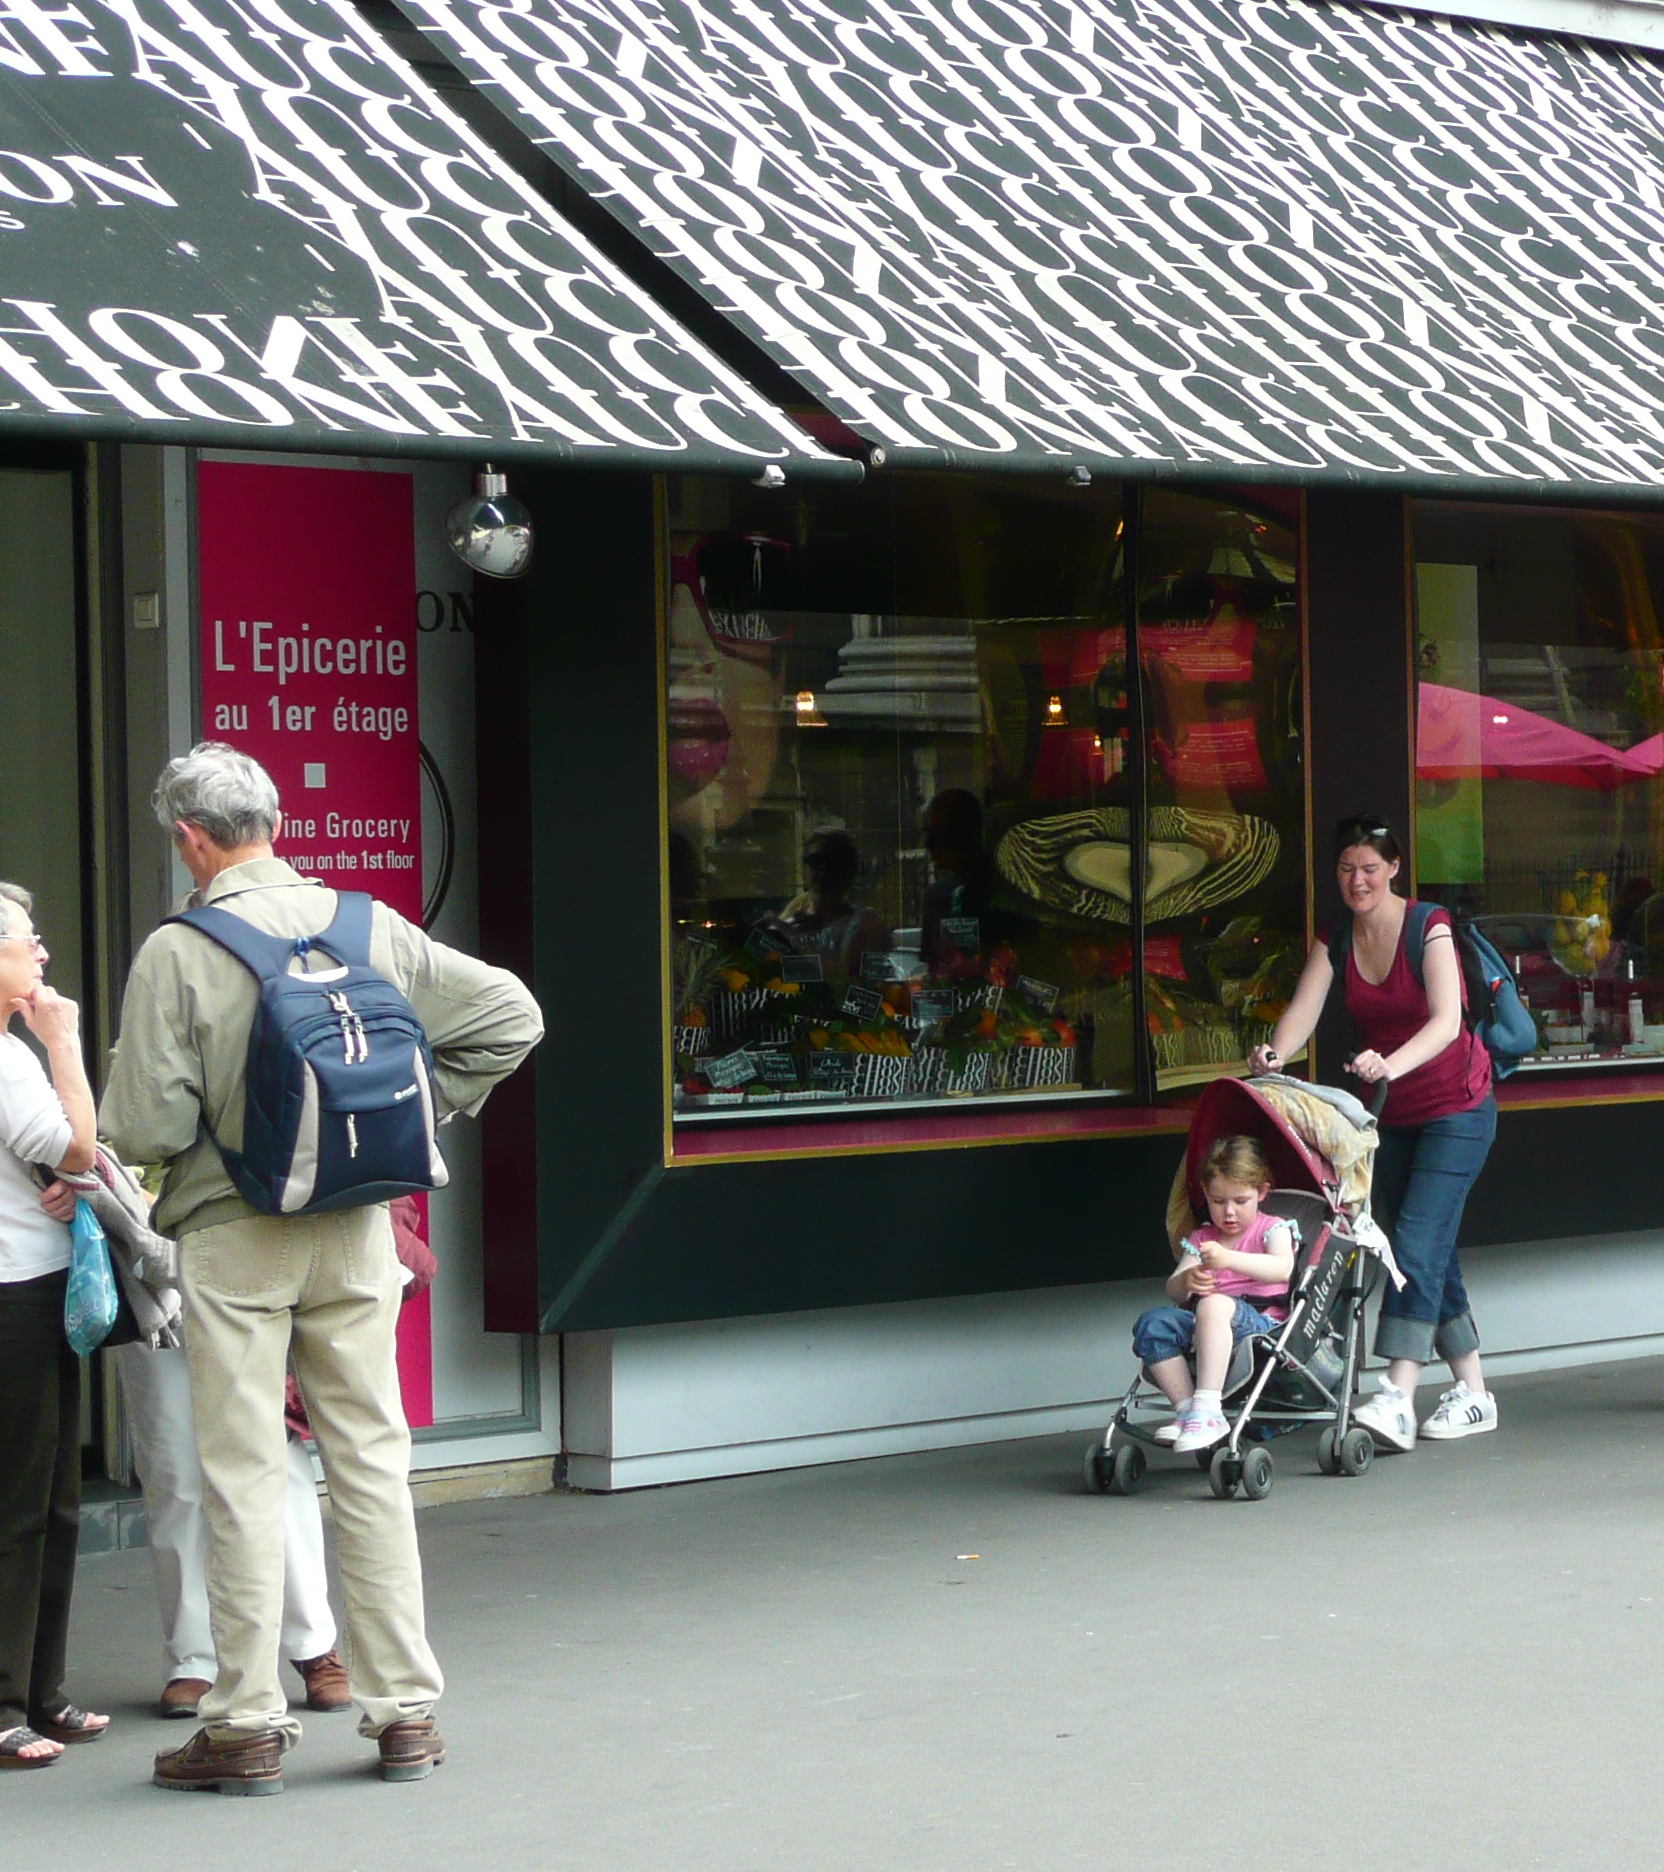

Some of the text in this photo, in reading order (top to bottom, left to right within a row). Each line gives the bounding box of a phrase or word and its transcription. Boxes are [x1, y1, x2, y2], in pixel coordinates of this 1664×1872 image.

[215, 620, 407, 685] L'Epicerie
[215, 695, 409, 741] au 1er étage
[284, 812, 411, 843] ine Grocery
[317, 854, 333, 870] on
[336, 850, 358, 870] the
[360, 850, 384, 870] 1st
[386, 850, 415, 869] floor
[1303, 1250, 1344, 1339] maclaren
